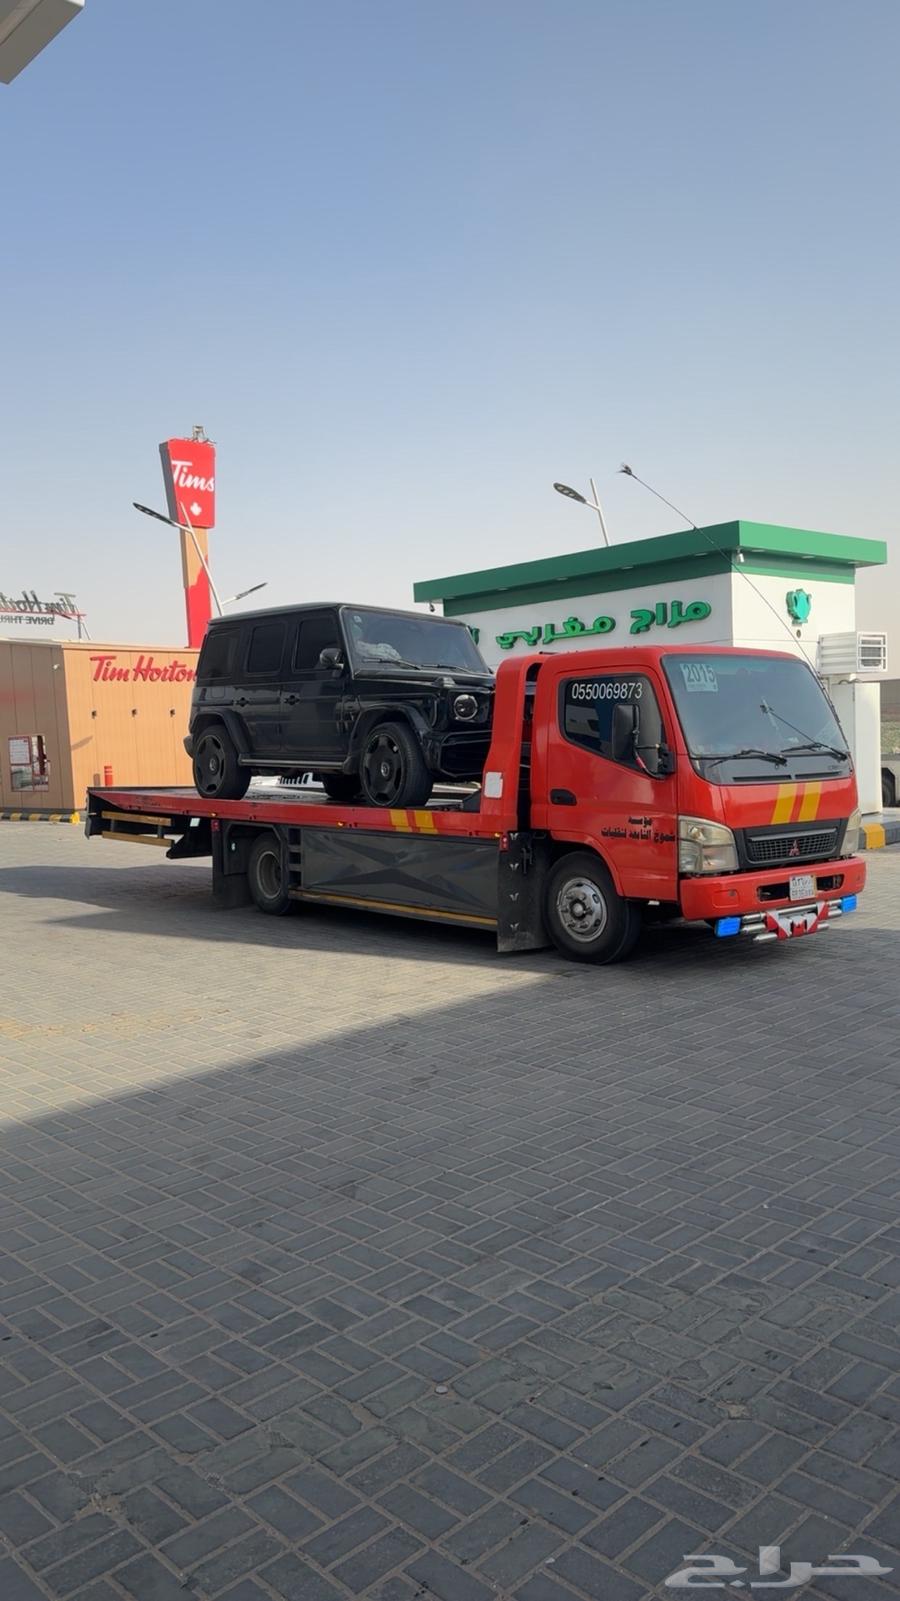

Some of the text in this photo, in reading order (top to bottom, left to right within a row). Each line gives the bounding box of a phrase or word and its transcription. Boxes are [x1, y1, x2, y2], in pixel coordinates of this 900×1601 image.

[171, 460, 215, 492] Tims
[630, 600, 712, 634] مزاج
[496, 616, 616, 649] مغربي
[90, 655, 130, 682] Tim
[683, 664, 715, 682] 2015
[571, 682, 643, 700] 0550069873
